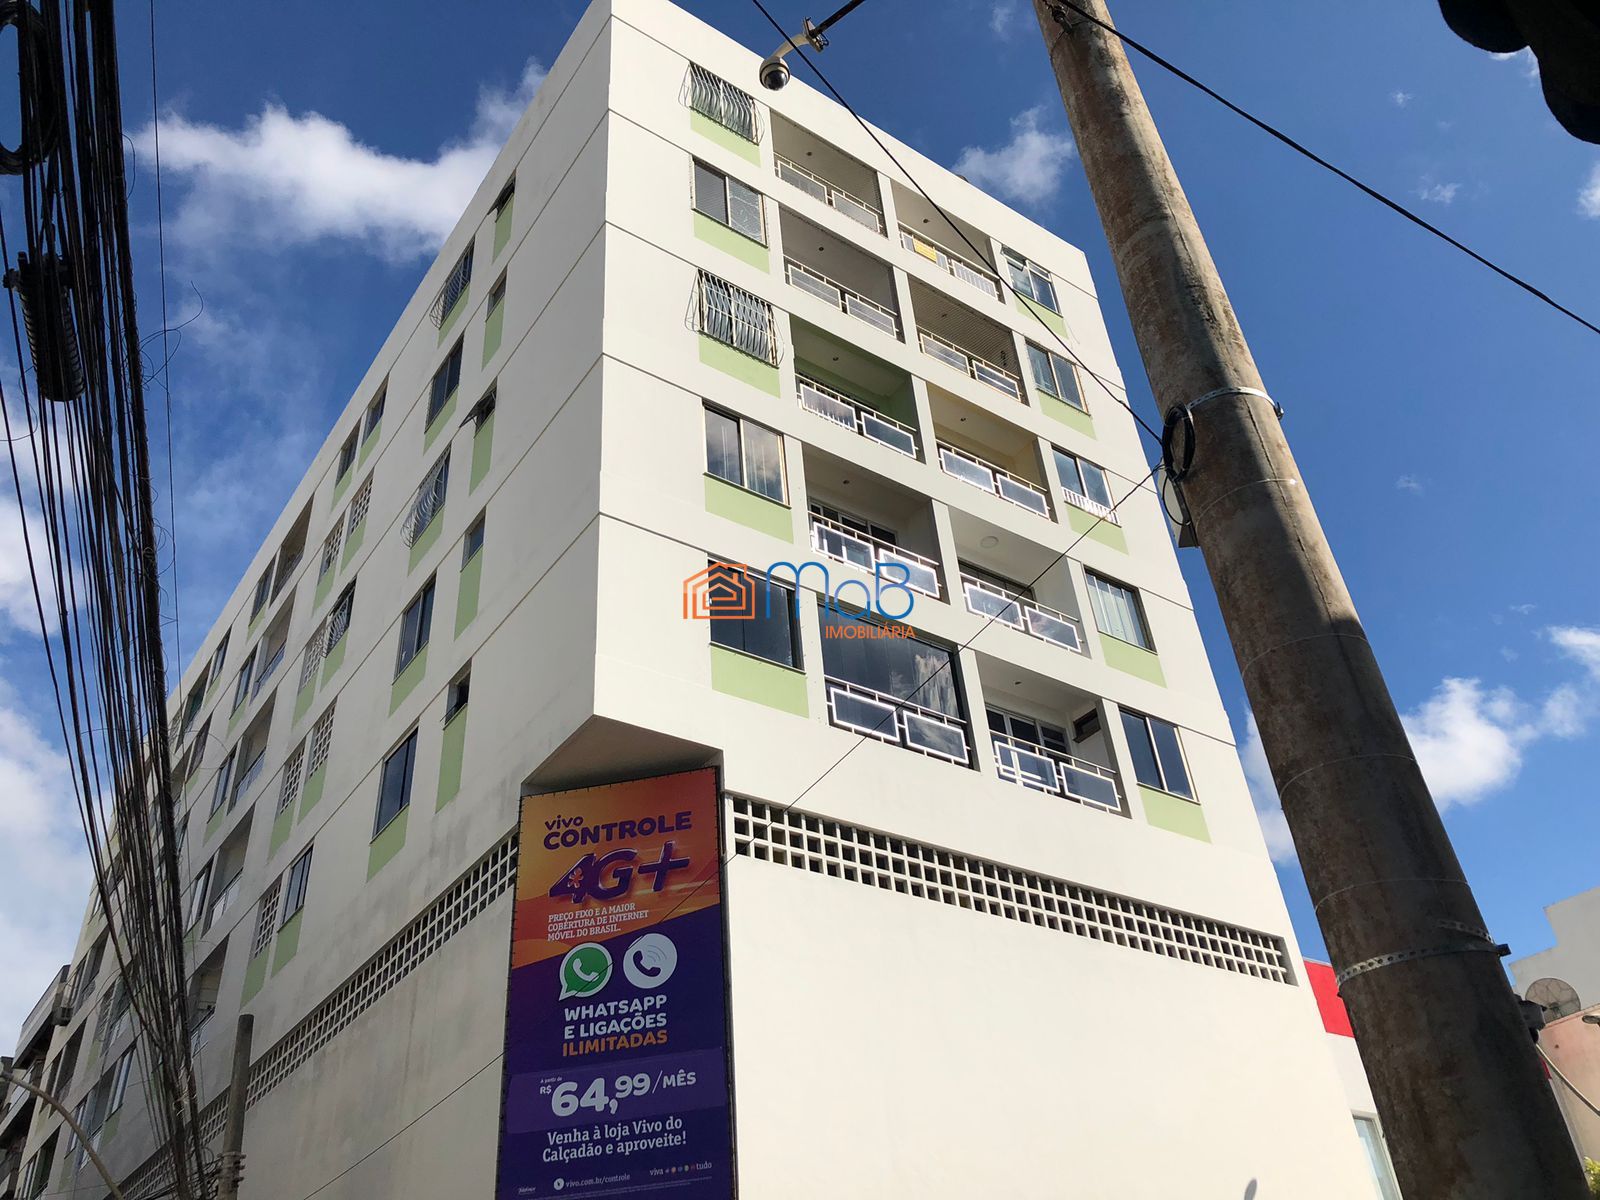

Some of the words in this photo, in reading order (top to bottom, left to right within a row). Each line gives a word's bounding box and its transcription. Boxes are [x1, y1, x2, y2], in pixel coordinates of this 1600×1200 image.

[543, 811, 692, 850] CONTROLE
[545, 814, 584, 831] vivo
[549, 840, 691, 903] 4G+
[547, 919, 595, 932] COBERTURA
[597, 916, 608, 925] DE
[609, 910, 649, 923] INTERNET
[548, 911, 574, 923] PREÇO
[575, 908, 594, 919] FIXO
[595, 908, 601, 916] E
[601, 907, 608, 915] A
[608, 902, 636, 914] MAIOR
[547, 929, 575, 941] MÓVEL
[577, 927, 588, 937] DO
[589, 924, 621, 936] BRASIL.
[564, 994, 667, 1022] WHATSAPP
[564, 1025, 575, 1040] E
[580, 1011, 667, 1038] LIGAÇÕES
[562, 1029, 668, 1057] ILIMITADAS
[540, 1085, 552, 1095] R$
[547, 1128, 590, 1145] Venha
[593, 1125, 601, 1140] à
[604, 1123, 630, 1141] loja
[632, 1119, 663, 1135] Vivo
[665, 1116, 683, 1130] do
[542, 1143, 603, 1163] Calçadão
[605, 1143, 614, 1154] e
[616, 1131, 687, 1155] aproveite!
[696, 1161, 712, 1171] tudo
[565, 1173, 631, 1188] vivo.com.br/controle
